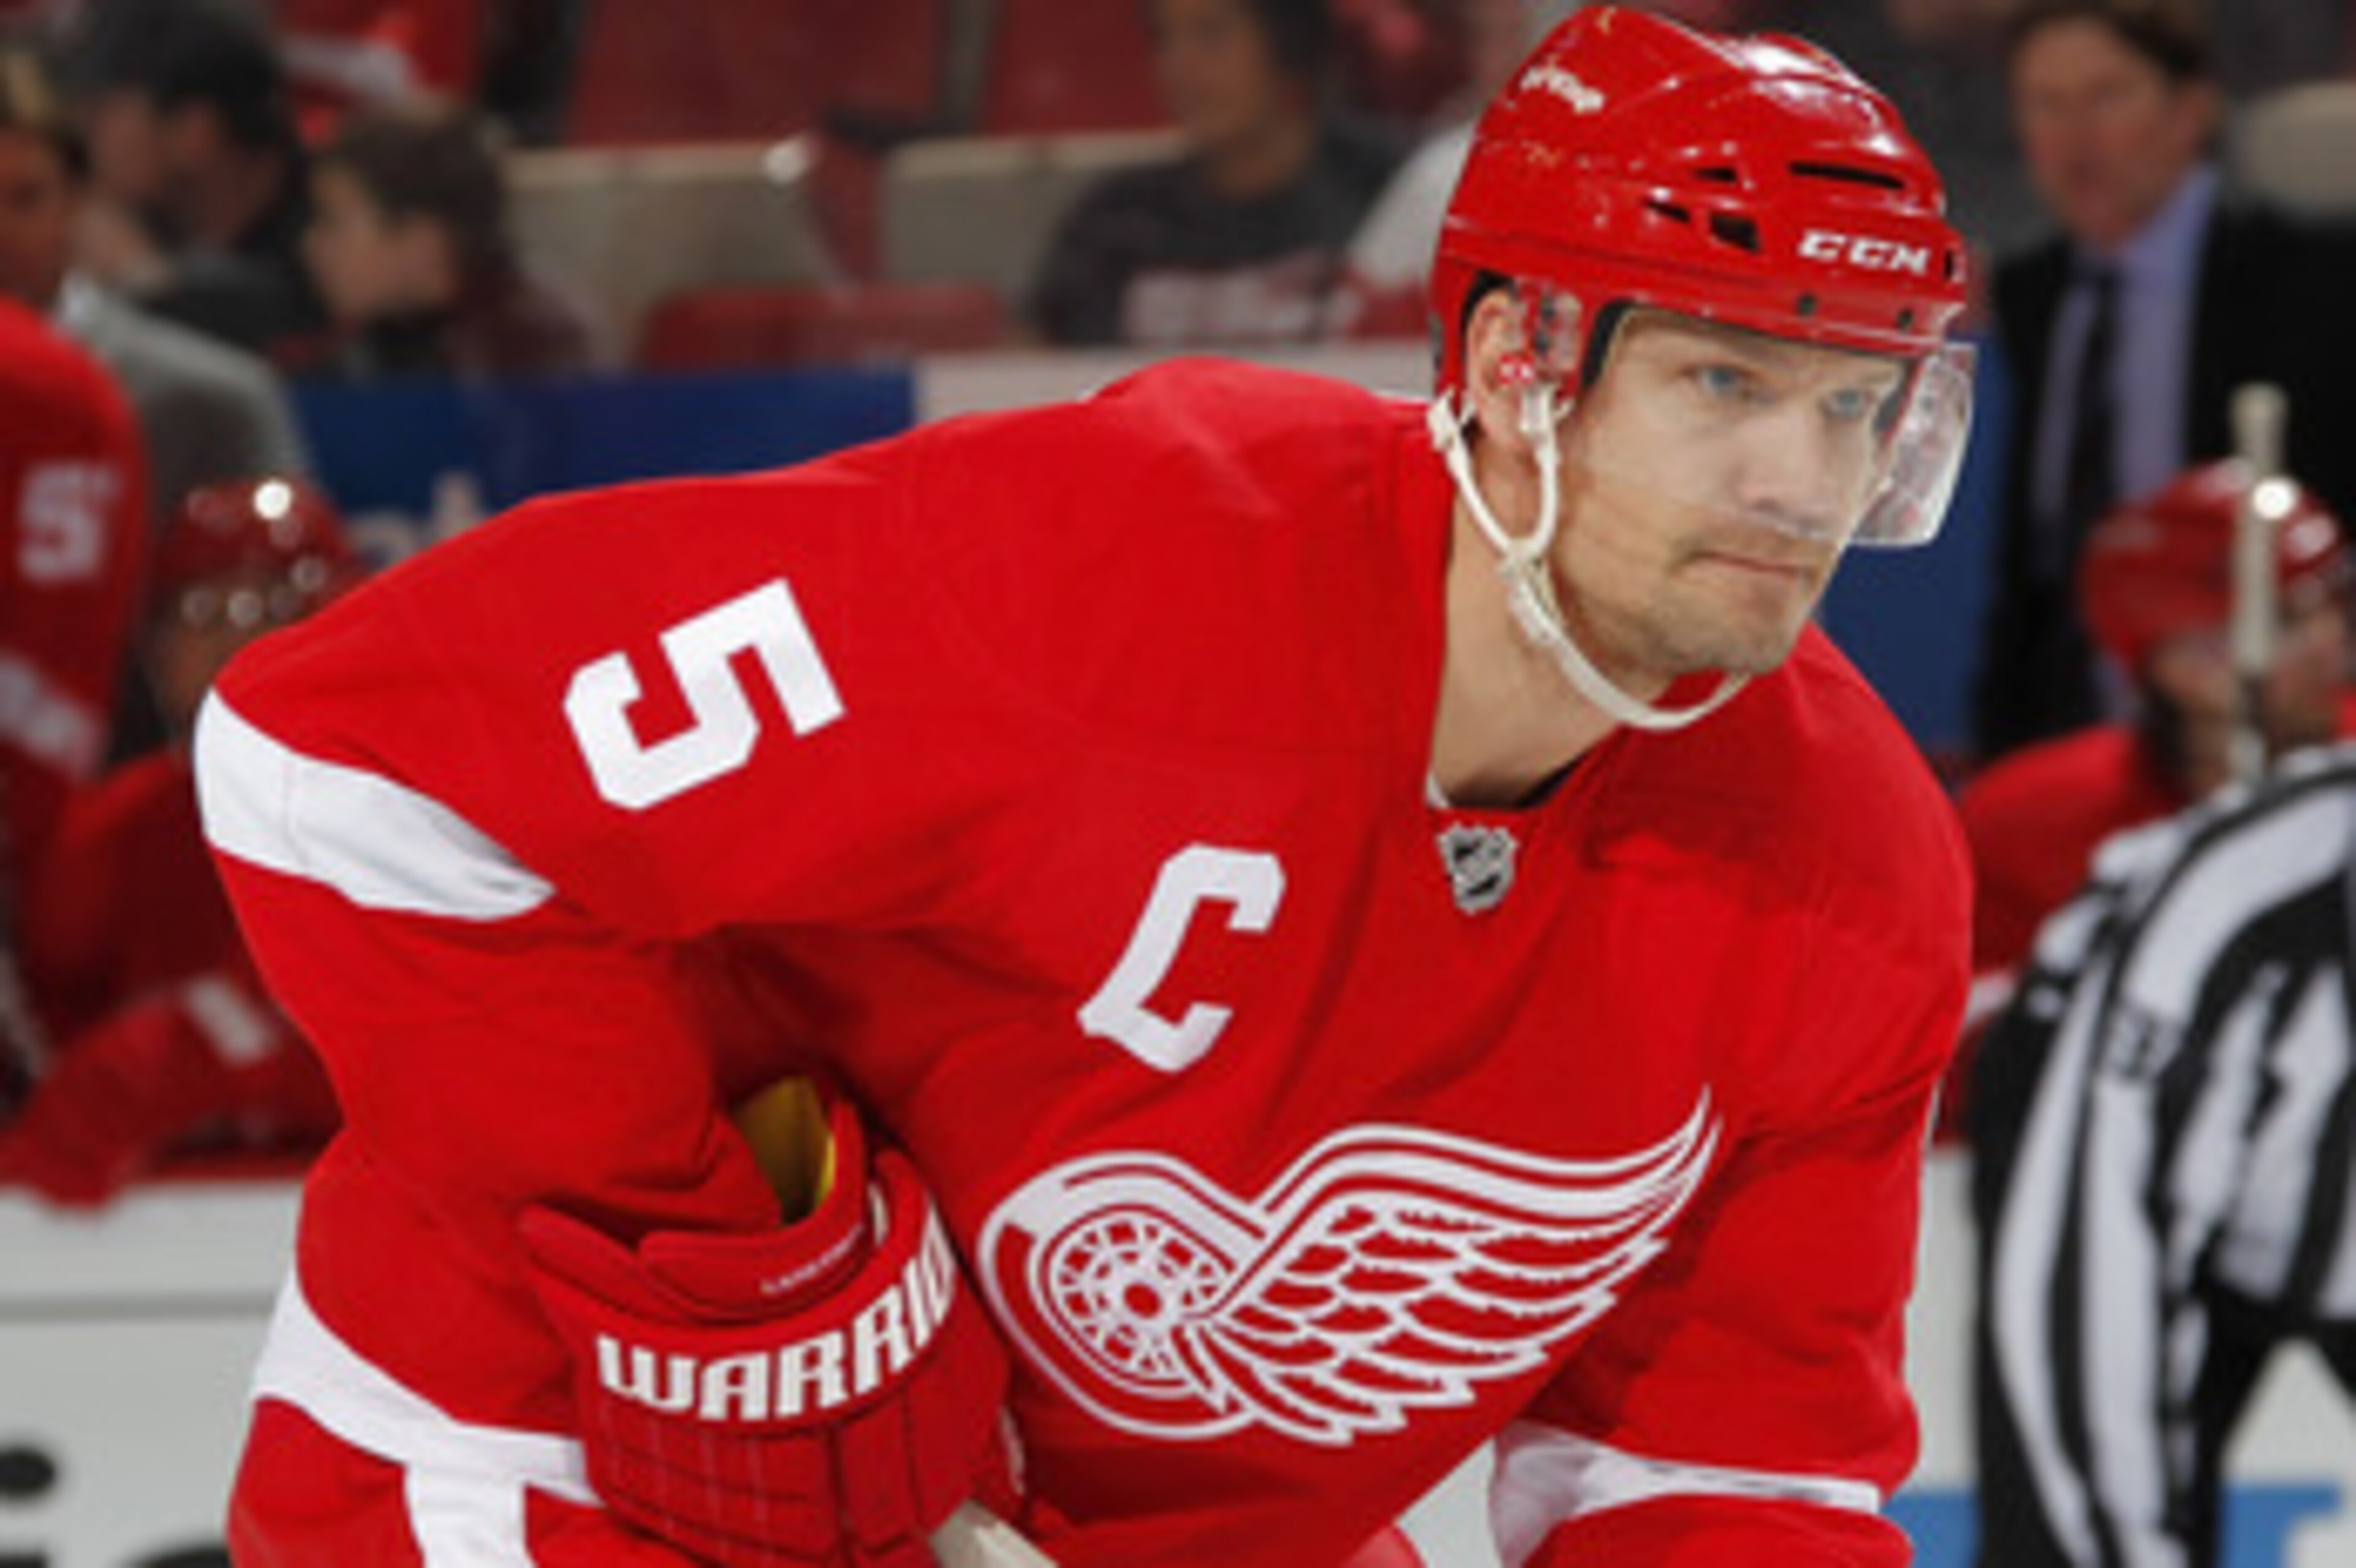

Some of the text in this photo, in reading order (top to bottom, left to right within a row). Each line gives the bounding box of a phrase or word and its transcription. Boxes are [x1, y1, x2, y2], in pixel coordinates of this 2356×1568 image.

[1799, 231, 1928, 273] CCM
[564, 579, 844, 809] 5
[1078, 844, 1285, 1070] C
[594, 1197, 955, 1421] WARRIO
